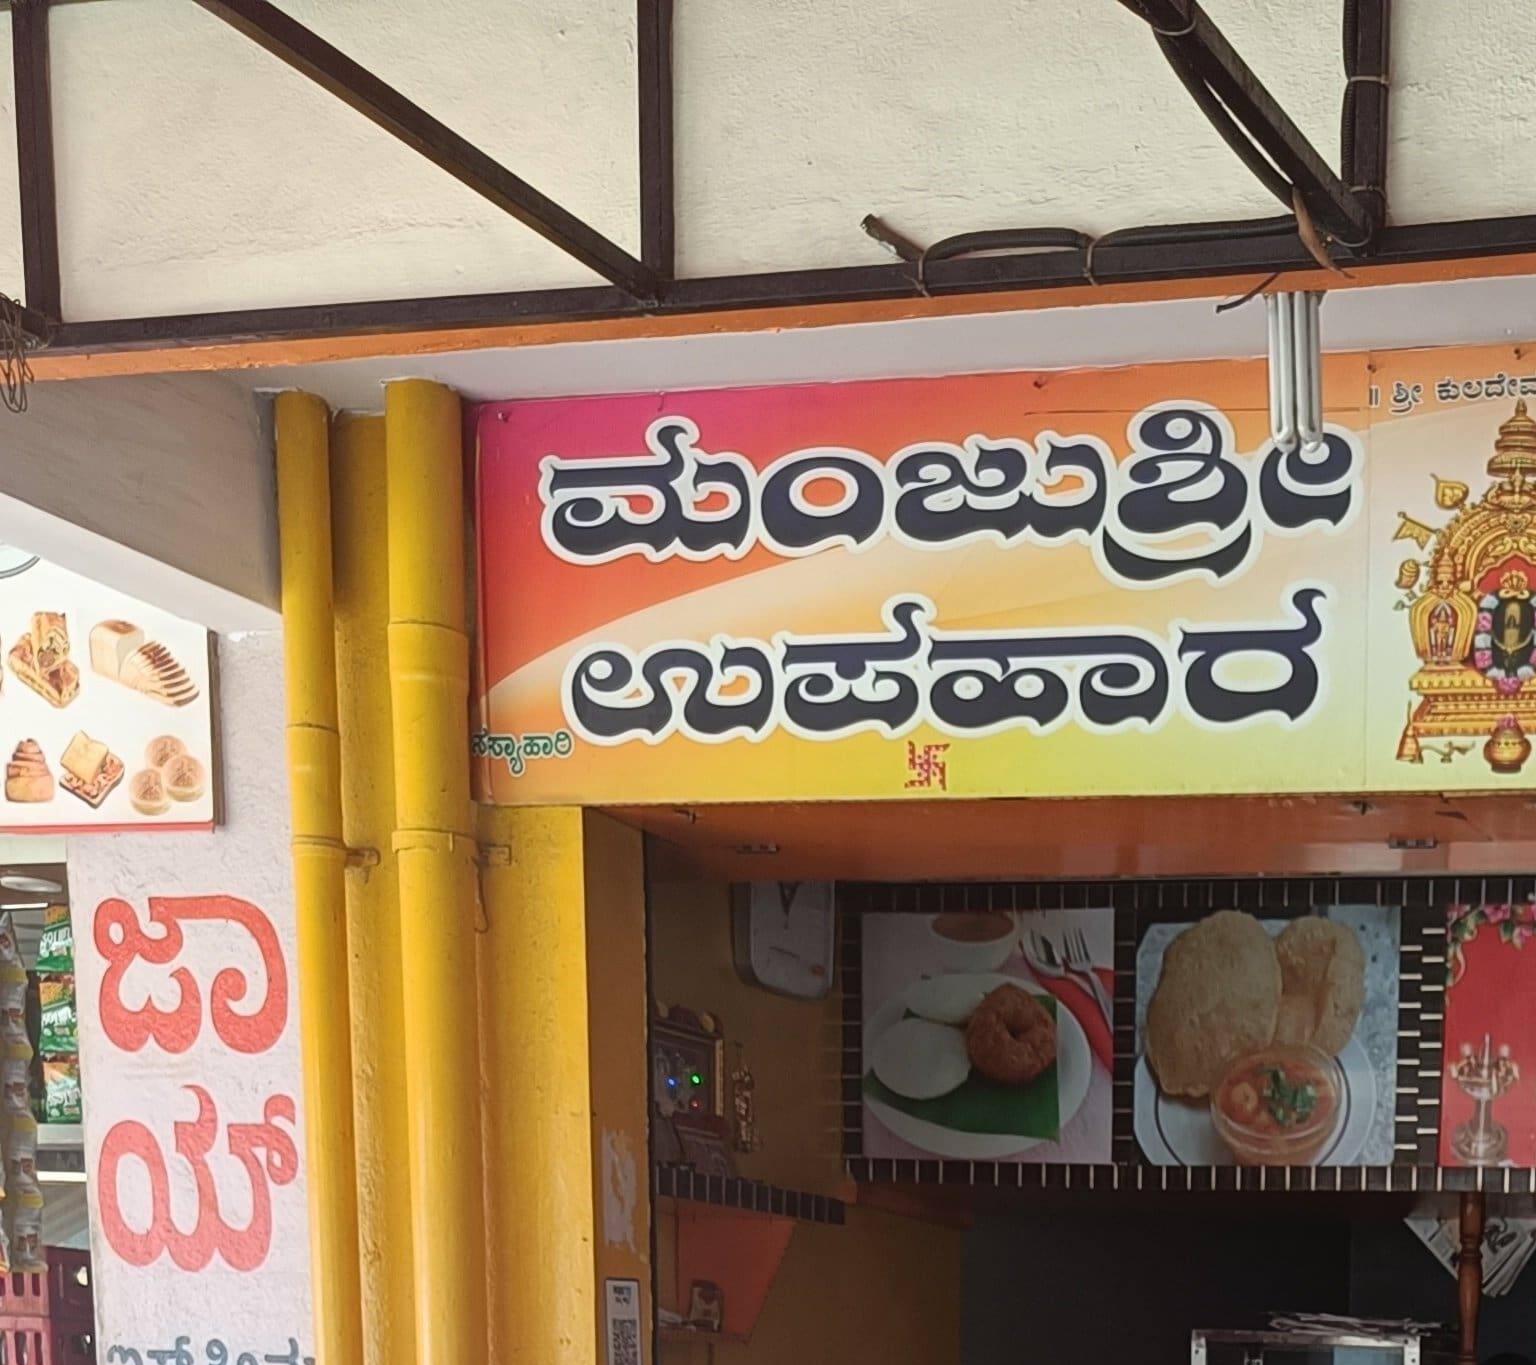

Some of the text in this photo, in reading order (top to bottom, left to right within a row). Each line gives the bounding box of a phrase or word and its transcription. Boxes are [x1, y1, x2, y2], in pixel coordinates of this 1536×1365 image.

[1391, 381, 1421, 412] ಶ್ರೀ
[541, 402, 1362, 586] ಮಂಜುಶ್ರೀ
[563, 585, 1337, 741] ಉಪಹಾರ
